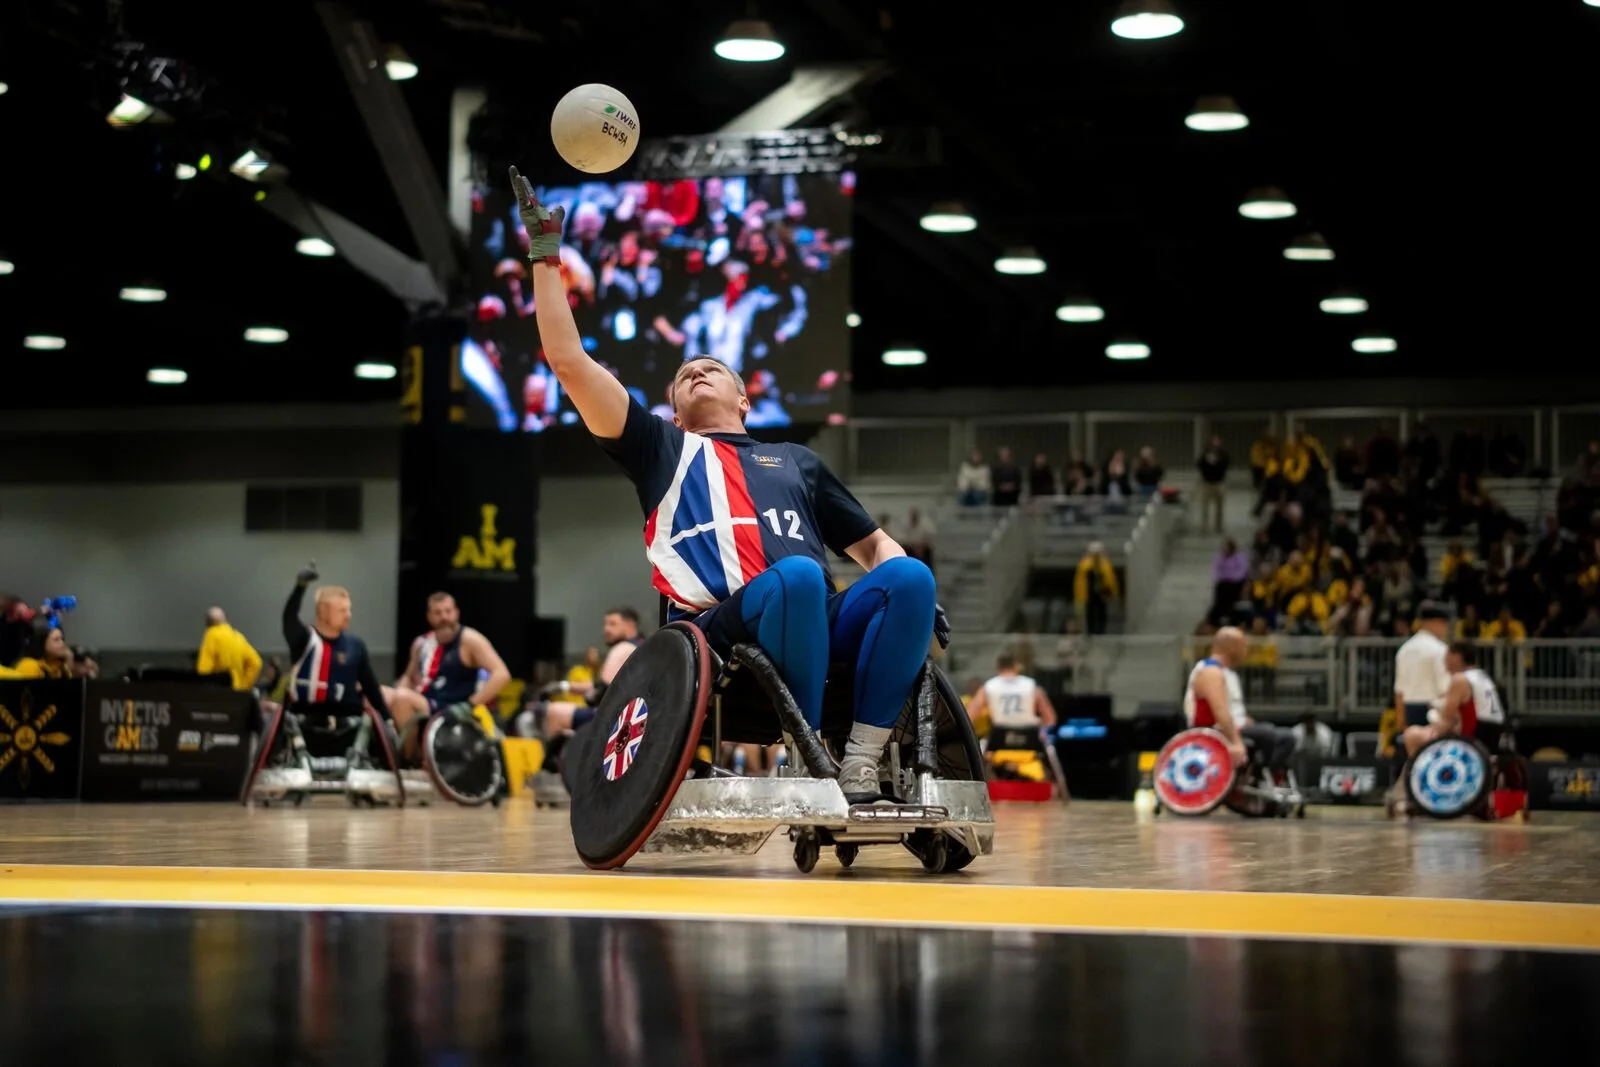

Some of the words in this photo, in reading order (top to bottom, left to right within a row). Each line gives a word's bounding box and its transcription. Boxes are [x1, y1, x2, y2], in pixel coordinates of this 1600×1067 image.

[481, 503, 498, 534] I
[762, 508, 804, 540] 12
[451, 535, 517, 570] AM
[100, 698, 171, 726] INVICTUS
[104, 725, 159, 751] GAMES
